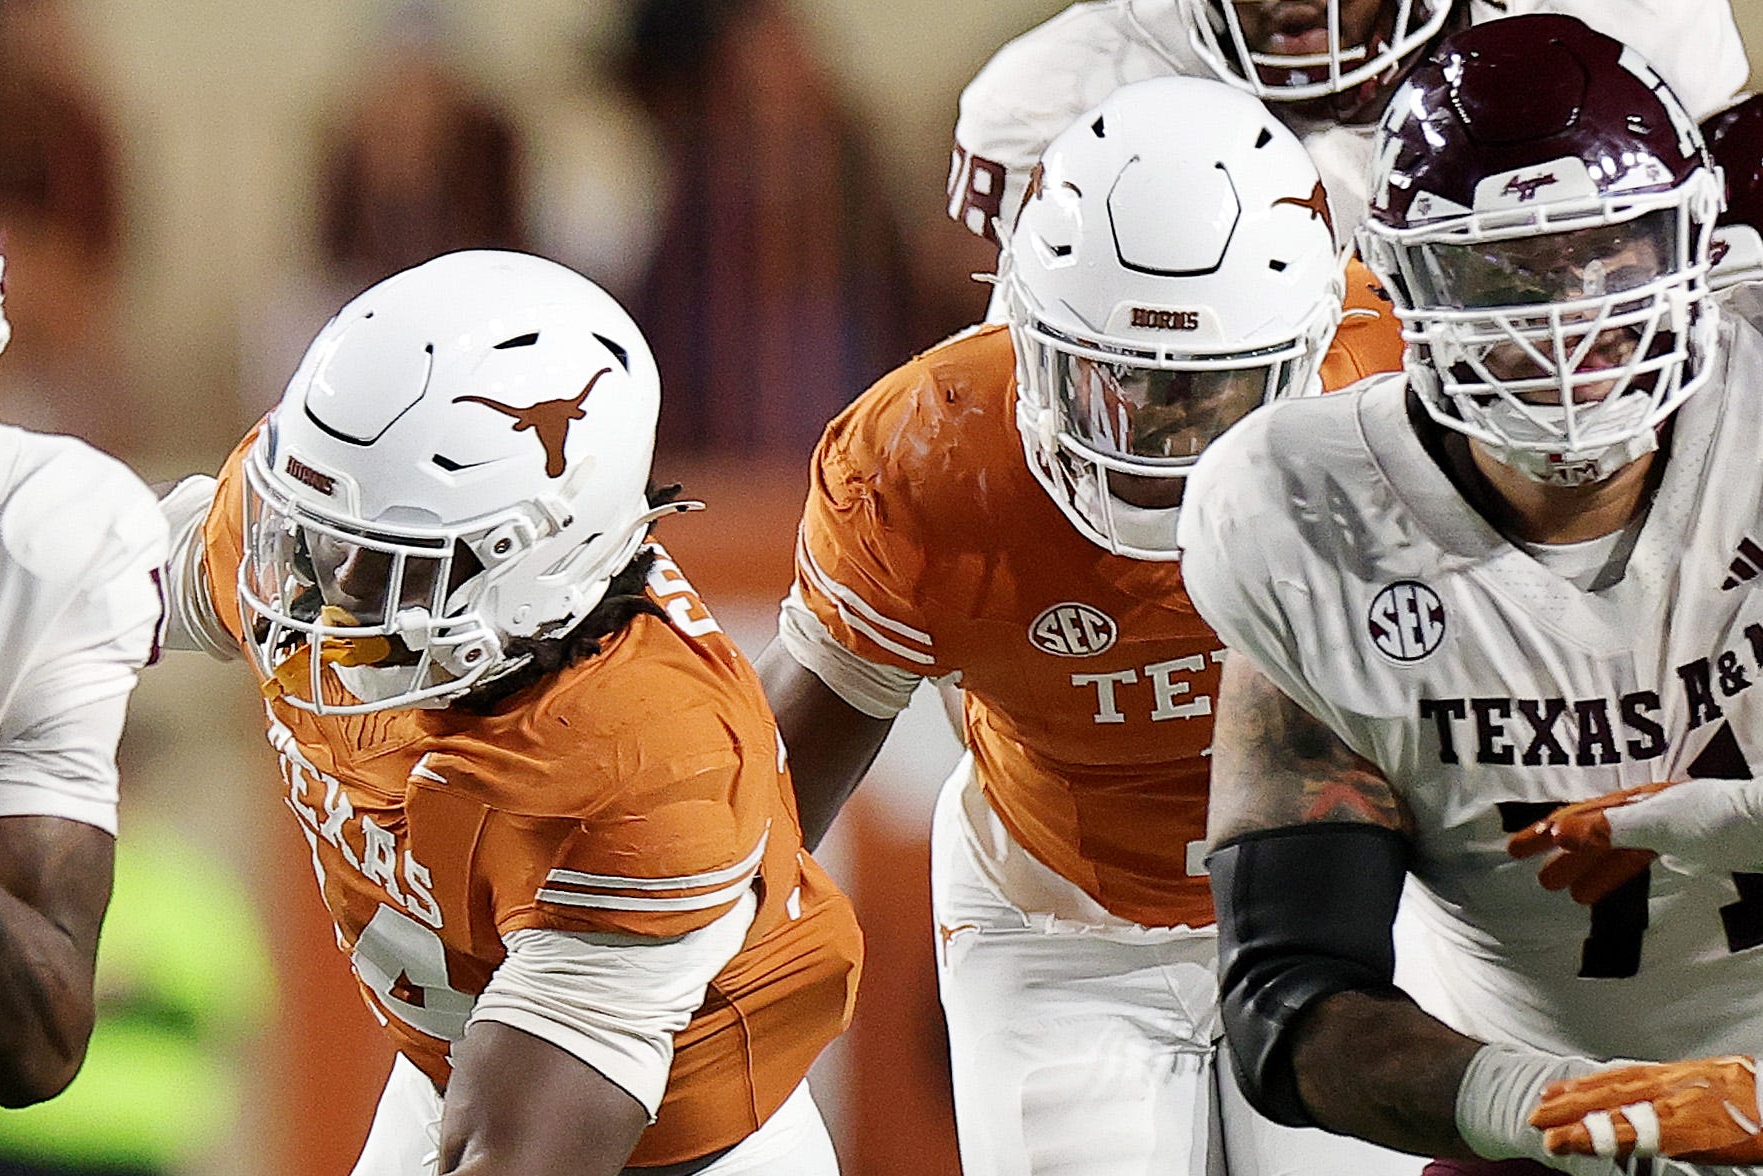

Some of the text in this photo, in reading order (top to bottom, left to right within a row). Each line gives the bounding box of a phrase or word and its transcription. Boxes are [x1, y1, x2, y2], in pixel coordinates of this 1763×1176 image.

[1130, 306, 1200, 331] HORNS
[1034, 604, 1113, 656] SEC
[1368, 580, 1446, 661] SEC
[1071, 647, 1231, 723] TE
[1419, 691, 1666, 766] TEXAS
